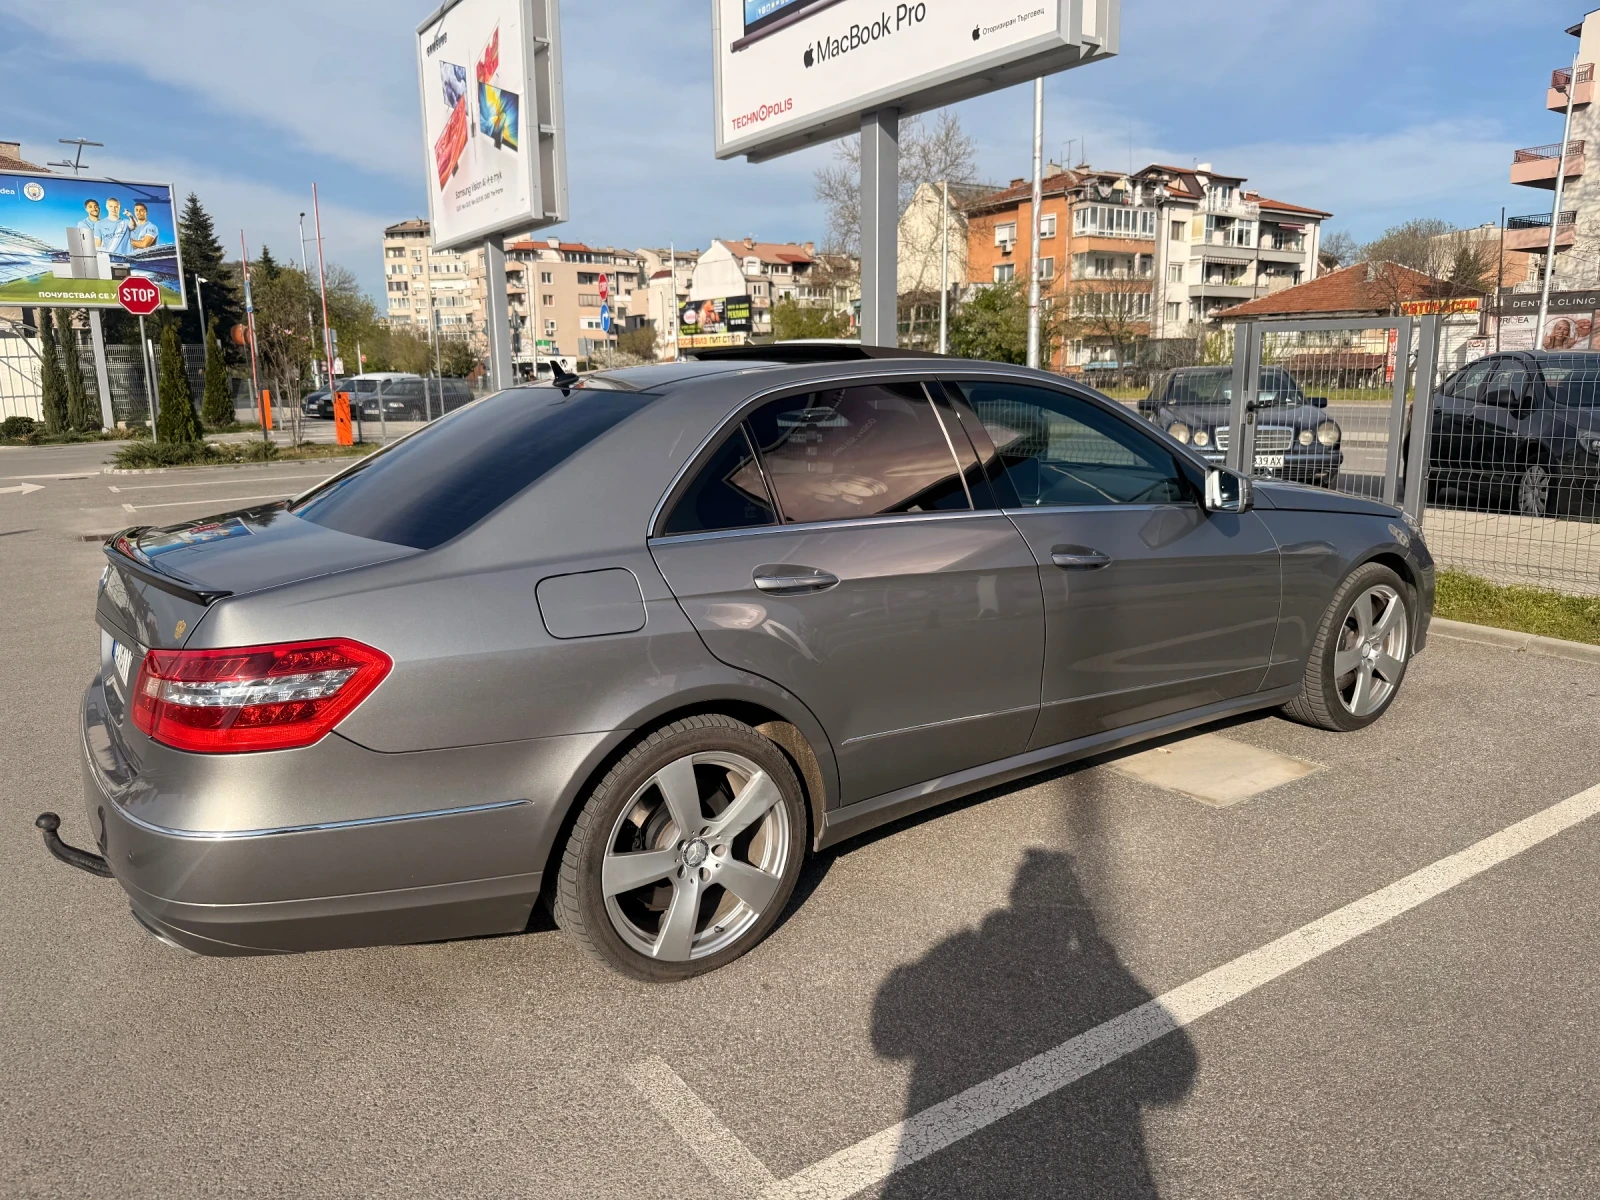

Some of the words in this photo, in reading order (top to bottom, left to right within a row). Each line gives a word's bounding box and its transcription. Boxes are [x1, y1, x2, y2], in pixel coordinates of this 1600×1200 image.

[982, 18, 1017, 35] Оторизиран
[1017, 7, 1045, 22] Търговец
[817, 12, 891, 64] MacBook
[896, 2, 926, 31] Pro
[731, 98, 793, 130] TECHNOPOLIS
[38, 291, 97, 299] ПОЧУВСТВАЙ
[122, 287, 156, 303] STOP
[1513, 299, 1555, 308] DENTL
[1557, 297, 1596, 306] CLINIC
